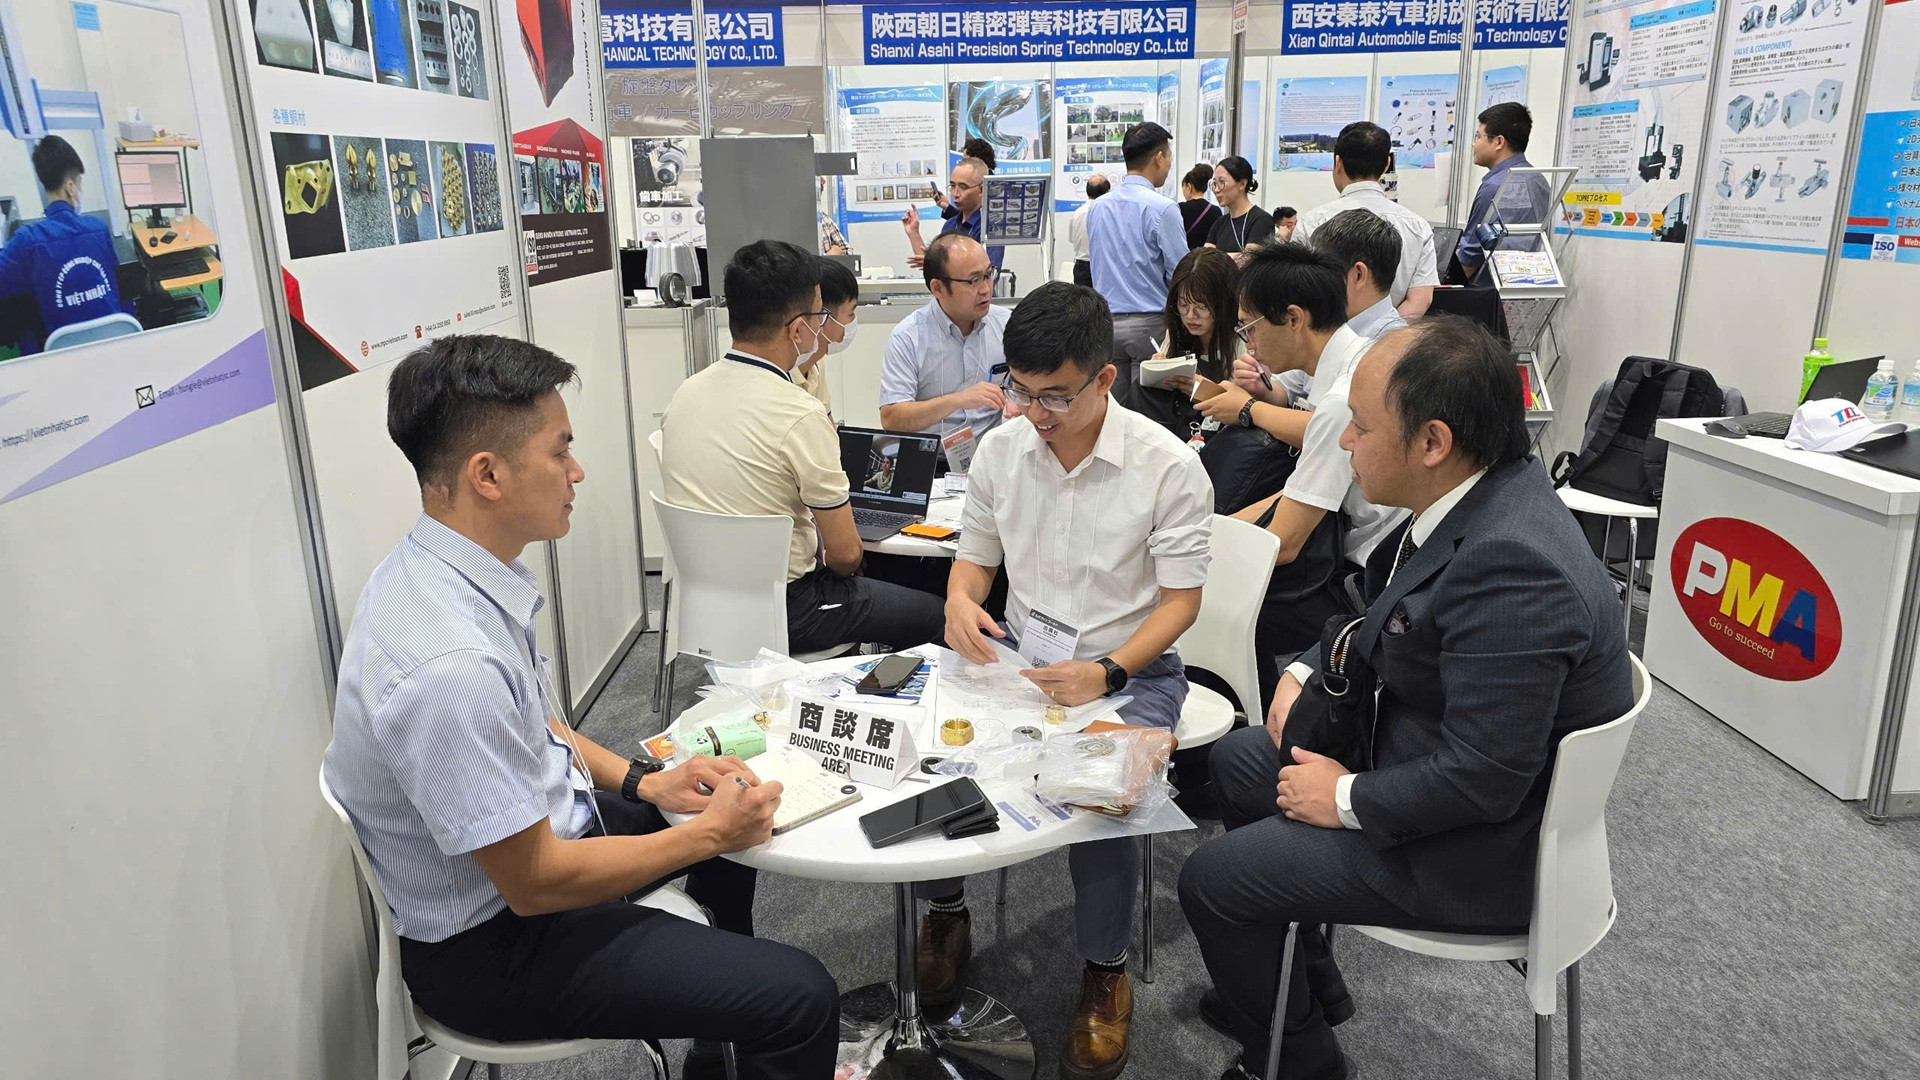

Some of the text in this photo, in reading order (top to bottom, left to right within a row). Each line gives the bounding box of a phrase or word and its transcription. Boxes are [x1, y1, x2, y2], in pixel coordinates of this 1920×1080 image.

[870, 37, 1188, 59] Shanxi Asahi Precision Spring Technology Co.,Ltd
[1288, 33, 1311, 48] Xian
[1319, 32, 1355, 48] Qintai
[1357, 29, 1425, 47] Automobile
[1428, 28, 1482, 45] Emissn
[1486, 26, 1556, 44] Technology
[1733, 45, 1749, 56] VALVE
[1754, 39, 1792, 53] COMPONENTS
[653, 45, 726, 62] TECHNOOGY
[729, 45, 751, 63] CO.,
[753, 44, 778, 61] LTD.
[639, 190, 684, 202] 歯車加工
[1874, 240, 1895, 251] ISO
[64, 284, 107, 306] VIỆT NHẬT
[158, 386, 175, 400] Email
[1683, 541, 1818, 663] PMA
[1709, 616, 1775, 660] Go to succeed
[799, 701, 895, 750] 商談席
[789, 732, 841, 757] BUSINESS
[842, 745, 895, 771] MEETING
